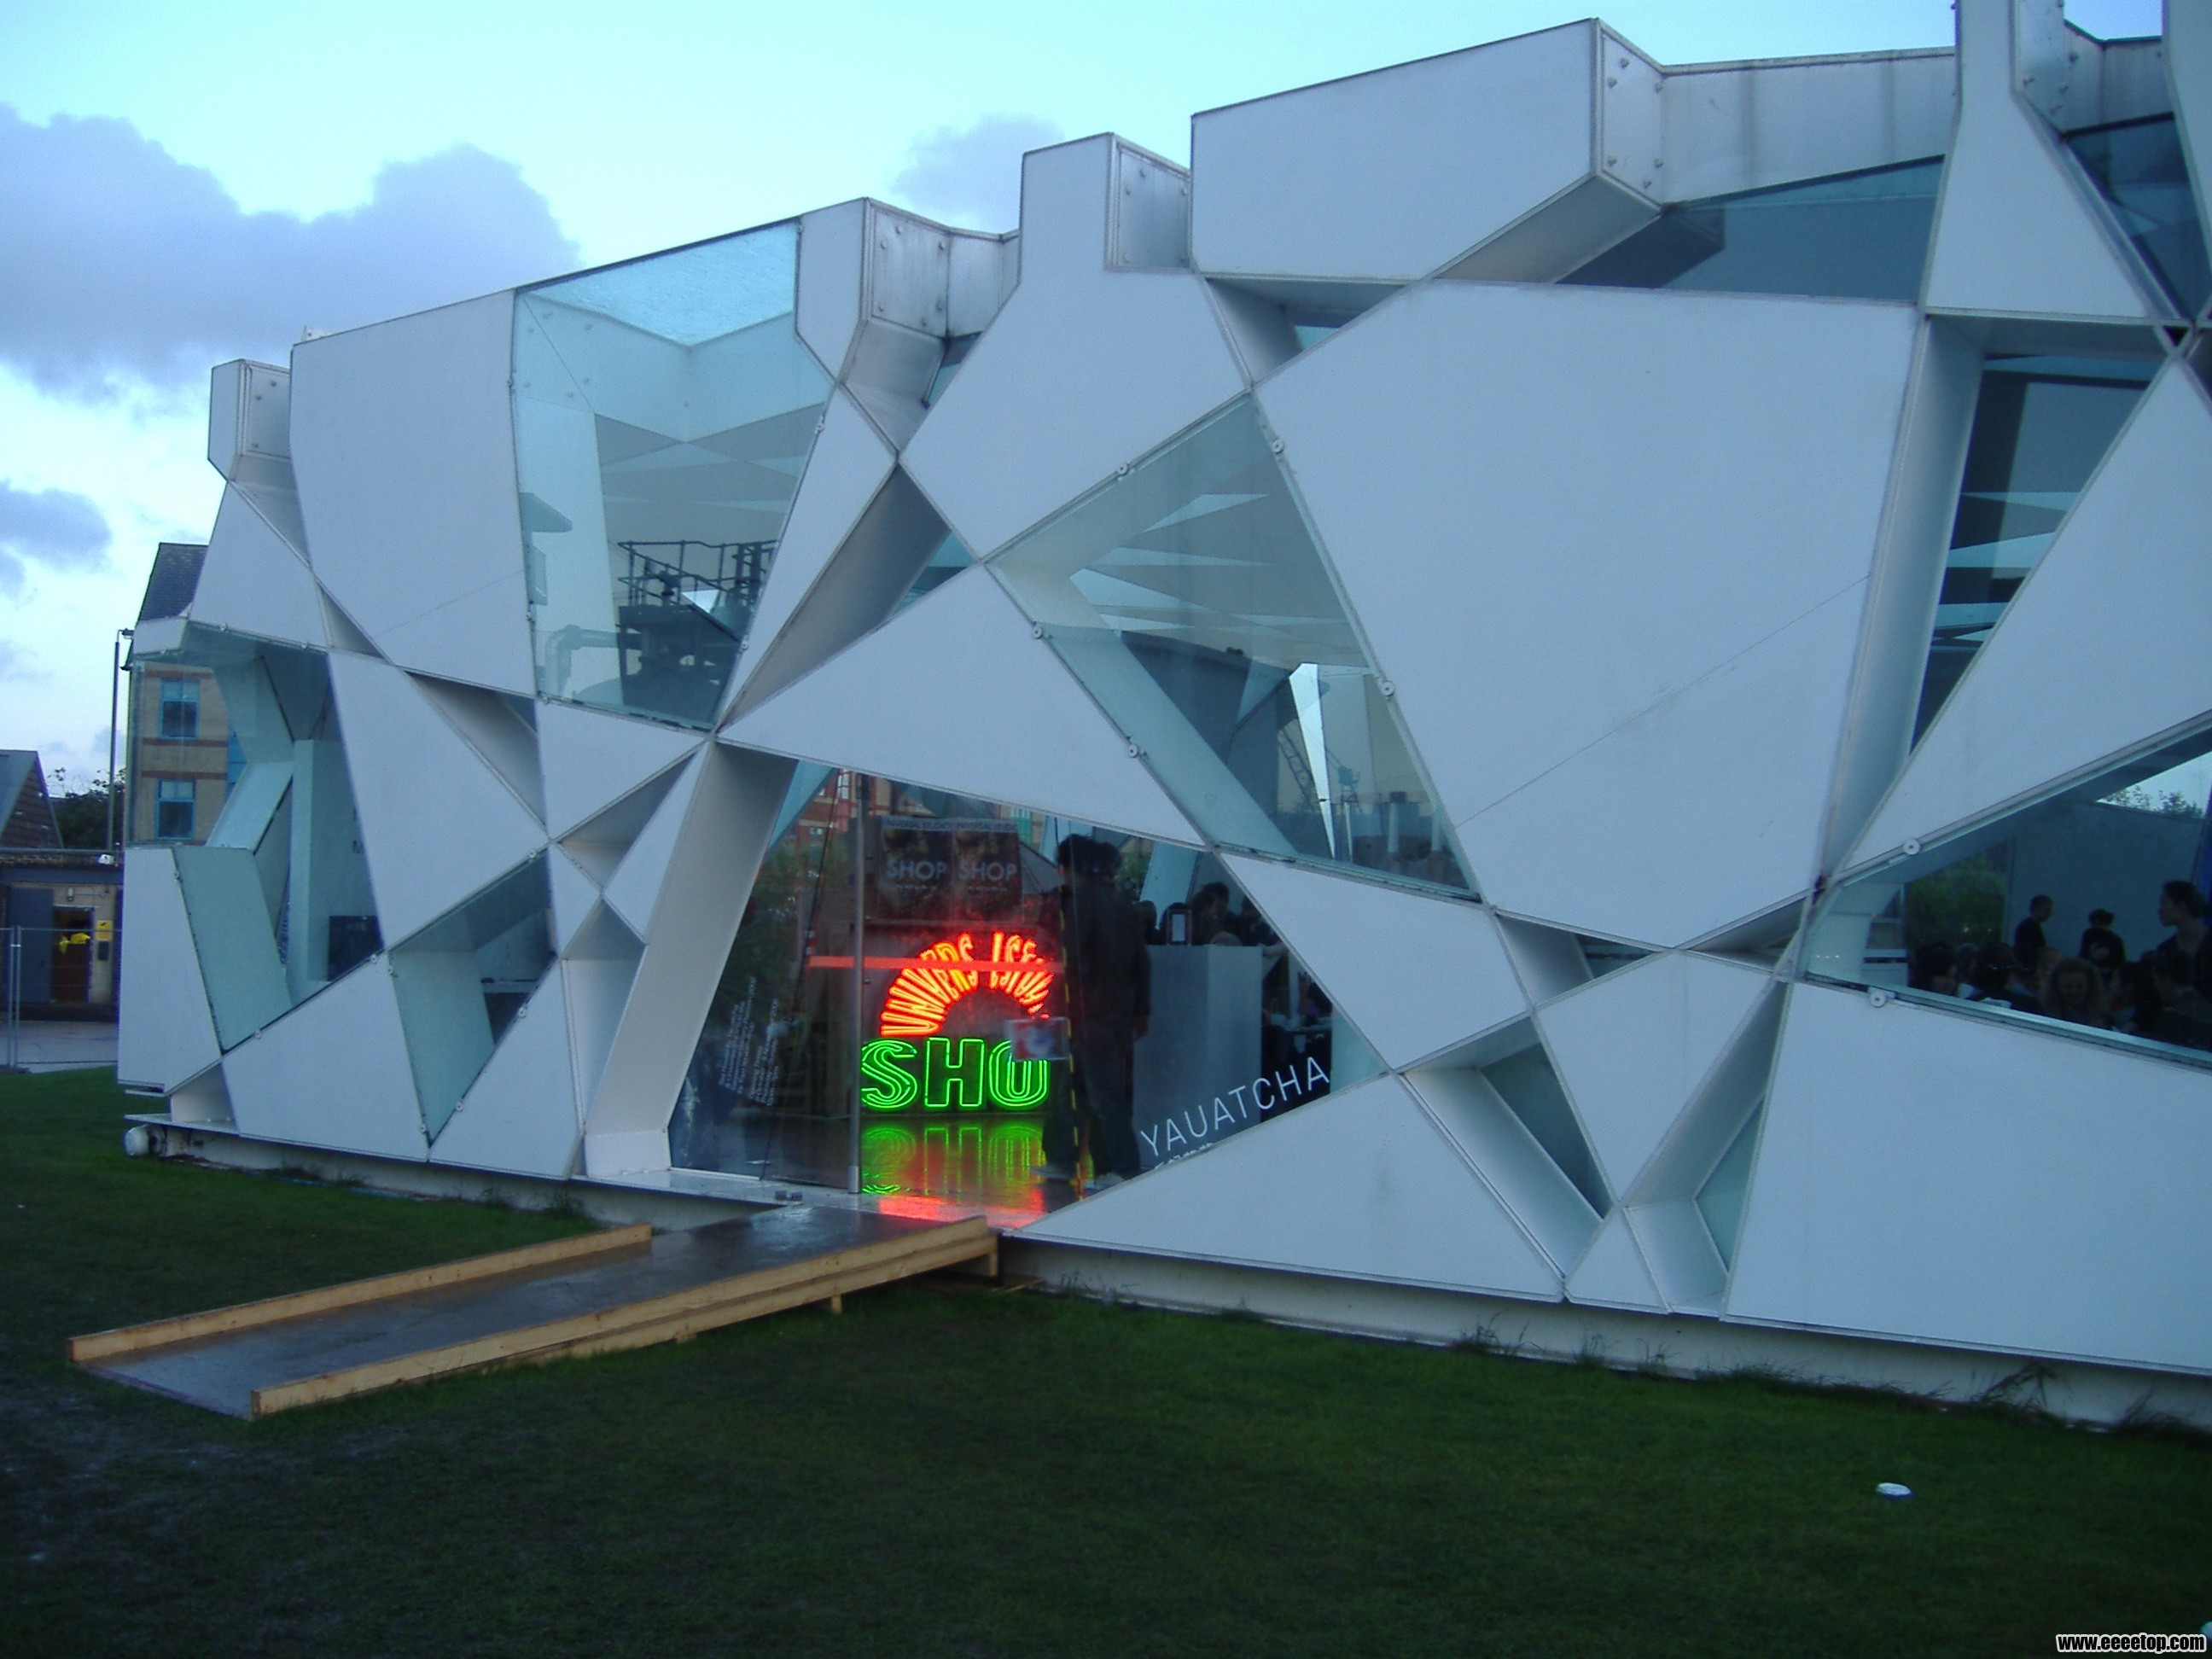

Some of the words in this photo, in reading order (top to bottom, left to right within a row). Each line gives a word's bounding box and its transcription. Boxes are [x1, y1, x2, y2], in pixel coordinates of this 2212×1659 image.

[887, 858, 947, 881] SHOP
[958, 859, 1018, 882] SHOP
[1140, 1056, 1330, 1157] YAUATCHA
